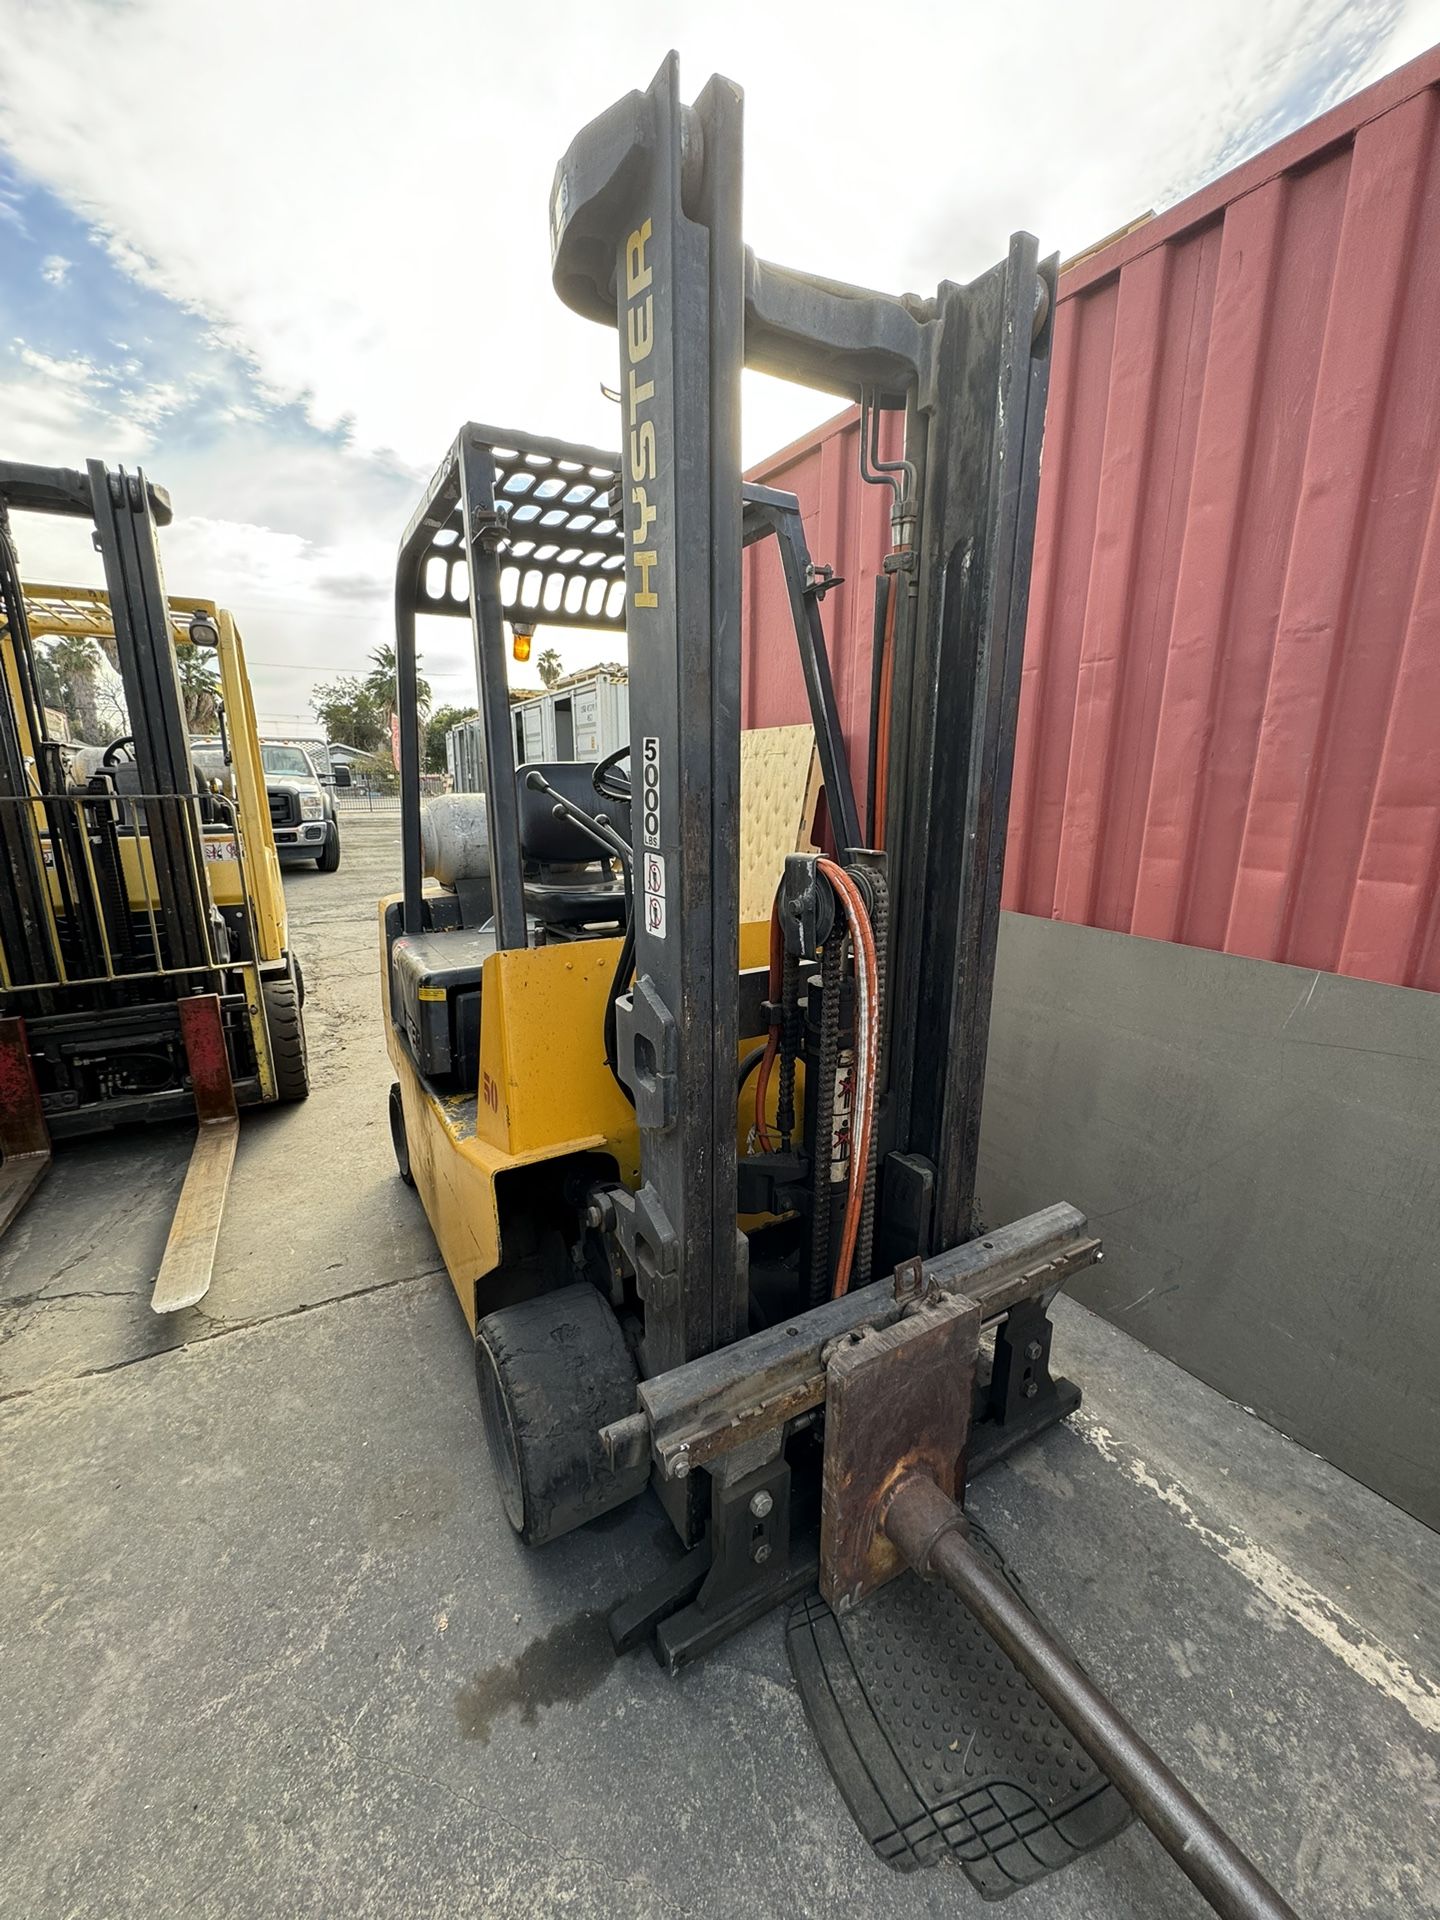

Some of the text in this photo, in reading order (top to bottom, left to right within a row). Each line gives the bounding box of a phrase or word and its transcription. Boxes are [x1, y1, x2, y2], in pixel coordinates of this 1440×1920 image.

[626, 217, 659, 608] HYSTER
[644, 738, 660, 836] 5000
[644, 835, 658, 847] LBS
[483, 1071, 498, 1114] 50
